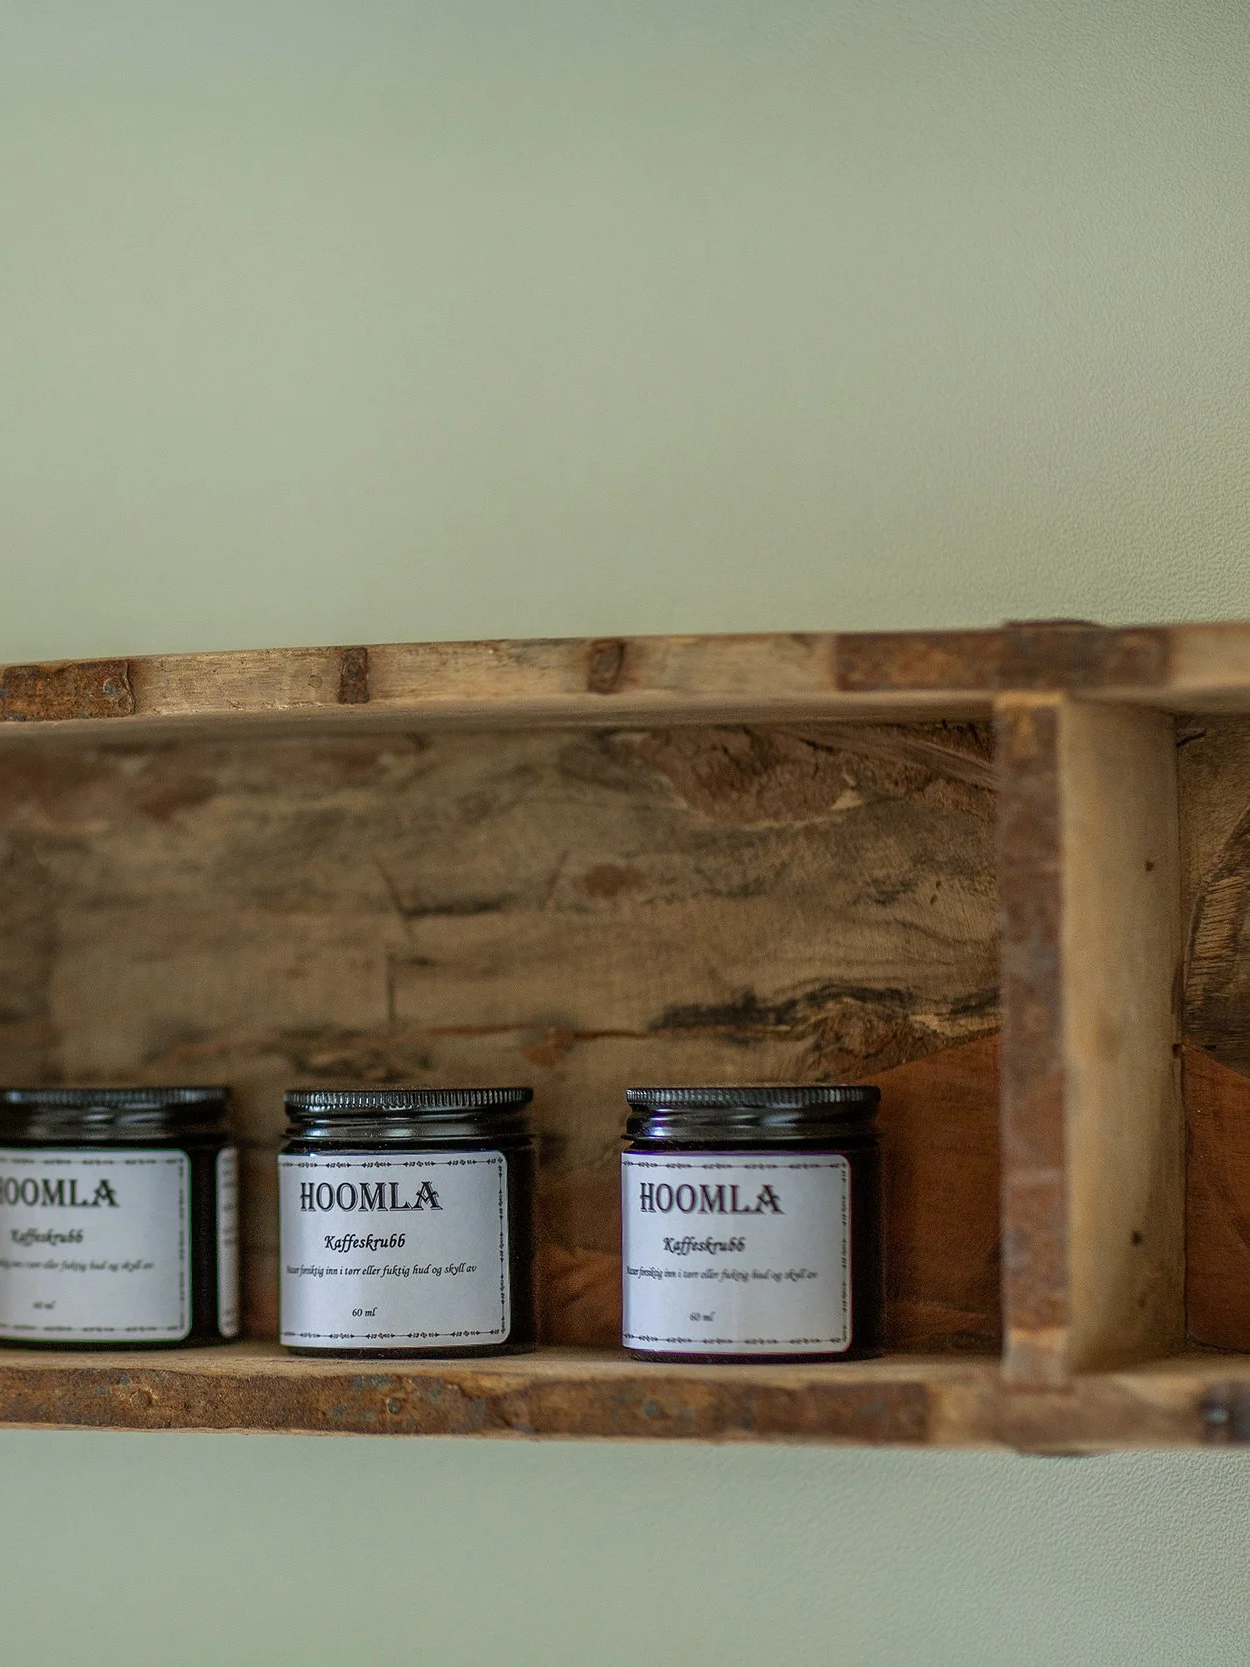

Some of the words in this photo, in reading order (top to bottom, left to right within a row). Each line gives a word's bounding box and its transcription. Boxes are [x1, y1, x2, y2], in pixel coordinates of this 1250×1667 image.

[300, 1181, 443, 1212] HOOMLA
[640, 1182, 786, 1215] HOOMLA
[324, 1233, 406, 1252] Kaffeskrubb
[662, 1236, 747, 1256] Kaffeskrubb
[362, 1264, 381, 1276] eller
[380, 1264, 411, 1278] fuktig
[412, 1264, 432, 1275] hud
[432, 1267, 443, 1277] og
[444, 1263, 466, 1277] skyll
[466, 1264, 477, 1273] av
[352, 1308, 363, 1317] 60
[364, 1307, 378, 1317] ml
